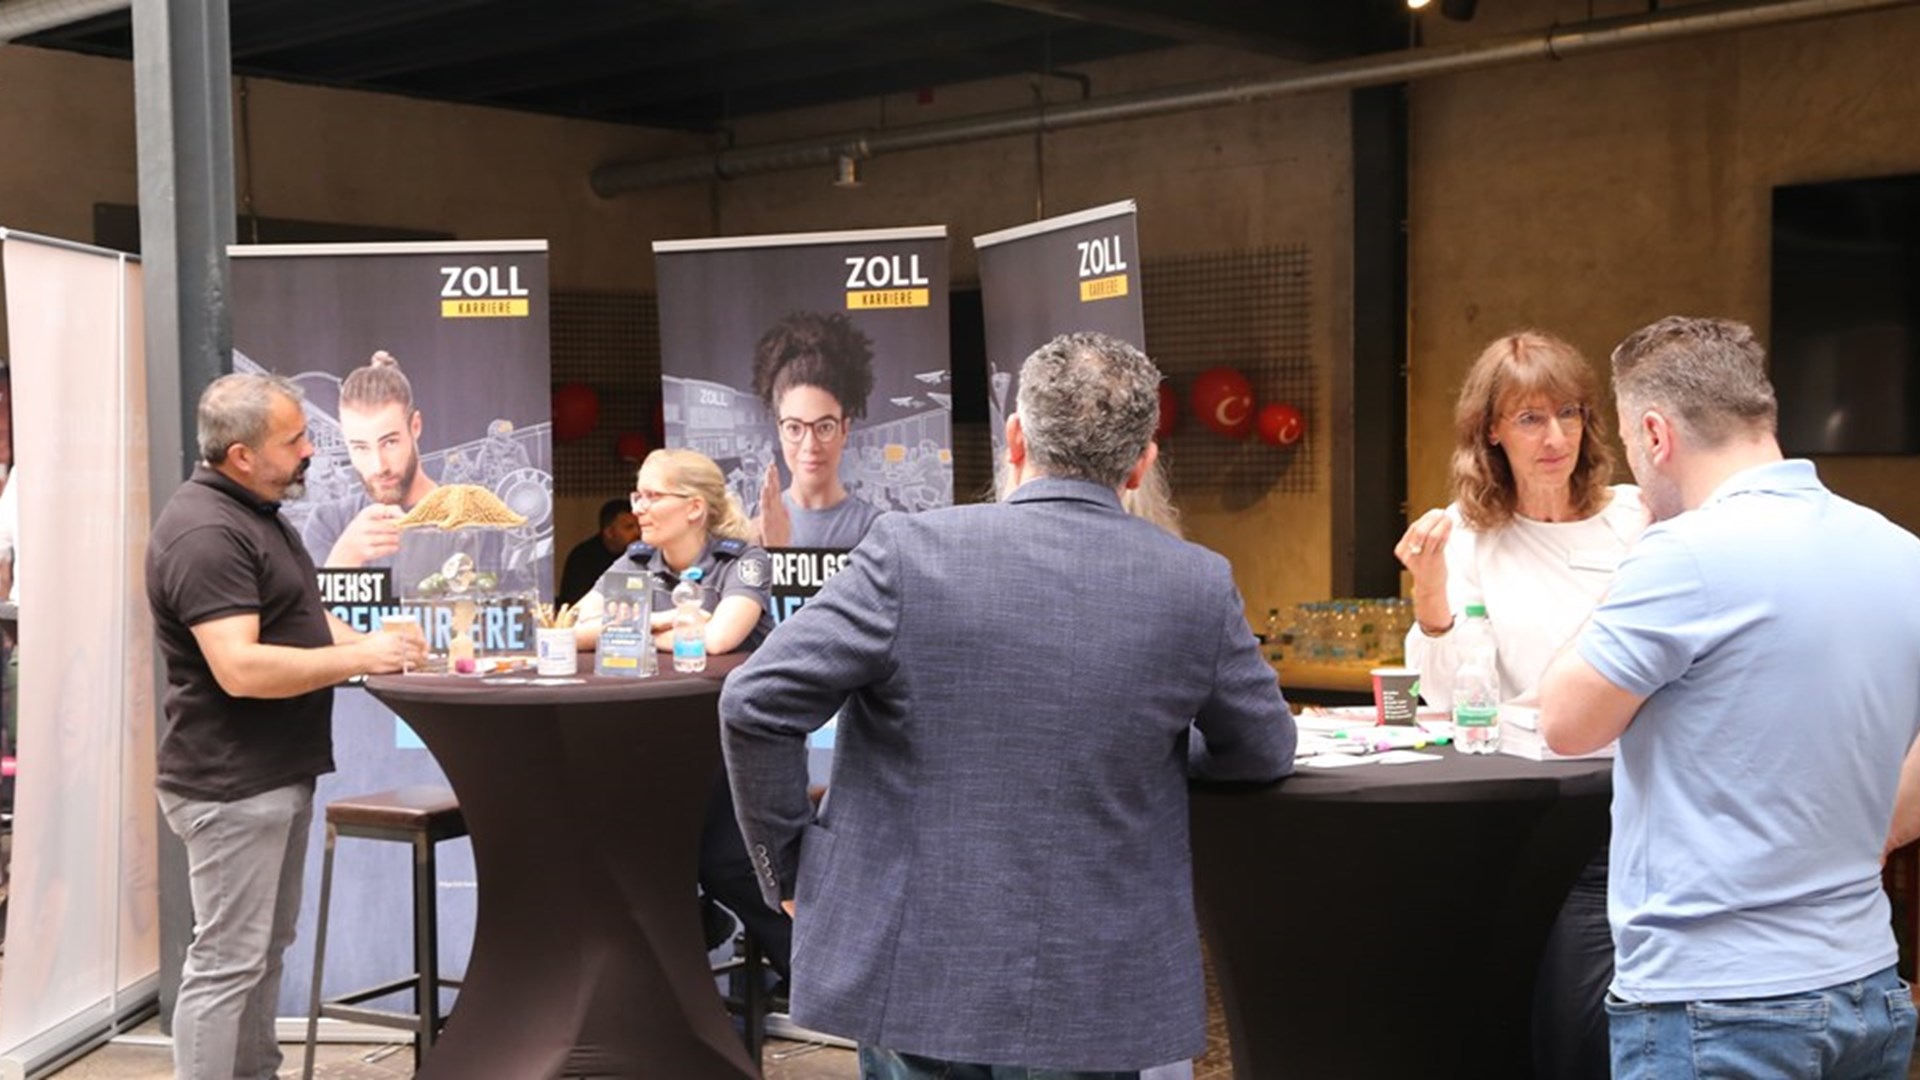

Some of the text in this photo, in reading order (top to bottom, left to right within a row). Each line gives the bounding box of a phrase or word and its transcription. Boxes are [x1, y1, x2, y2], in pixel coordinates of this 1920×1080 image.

[845, 254, 929, 288] ZOLL
[1077, 235, 1127, 277] ZOLL
[440, 266, 529, 297] ZOLL
[458, 301, 511, 314] KARRIERE
[862, 291, 912, 305] KARRIERE
[767, 553, 850, 588] RFOLG
